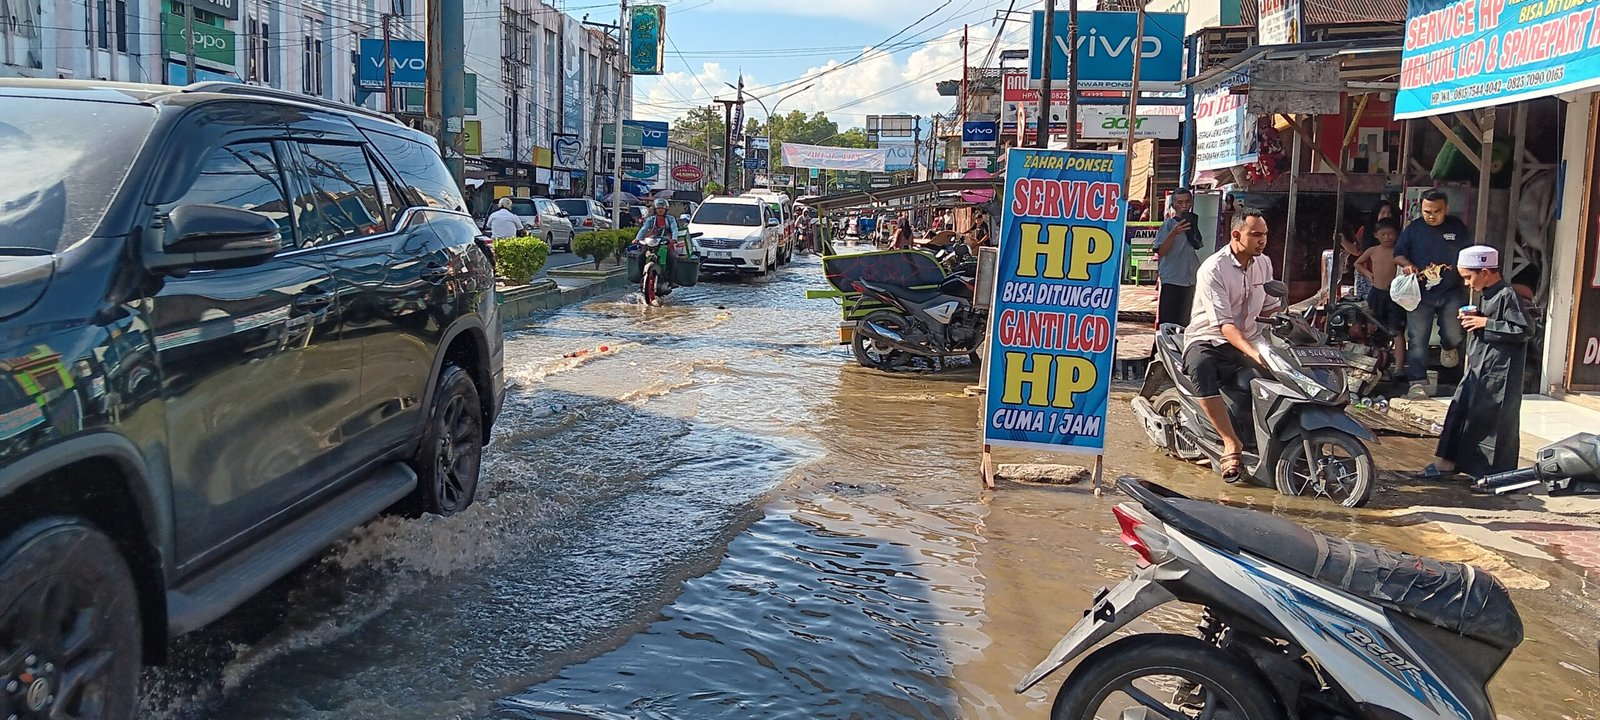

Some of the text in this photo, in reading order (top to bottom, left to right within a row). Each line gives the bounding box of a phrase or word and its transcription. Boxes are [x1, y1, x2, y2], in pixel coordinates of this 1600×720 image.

[1407, 0, 1505, 50] SERVICE HP
[1519, 2, 1543, 23] BISA
[1054, 27, 1162, 58] vivo
[1401, 47, 1455, 89] MENJUAL
[1458, 40, 1485, 78] LCD
[1486, 36, 1498, 74] &
[1501, 9, 1593, 70] SPAREPART
[370, 56, 425, 70] vvo
[1197, 100, 1214, 119] DI
[1024, 155, 1114, 173] ZAHRA PONSEL
[1012, 178, 1120, 221] SERVICE
[1135, 230, 1157, 238] ANW
[1016, 222, 1114, 281] HP
[1002, 281, 1114, 309] BISA DITUNGGU
[999, 309, 1110, 353] GANTI LCD
[1001, 351, 1098, 409] HP
[992, 408, 1102, 437] CUMA 1 JAM
